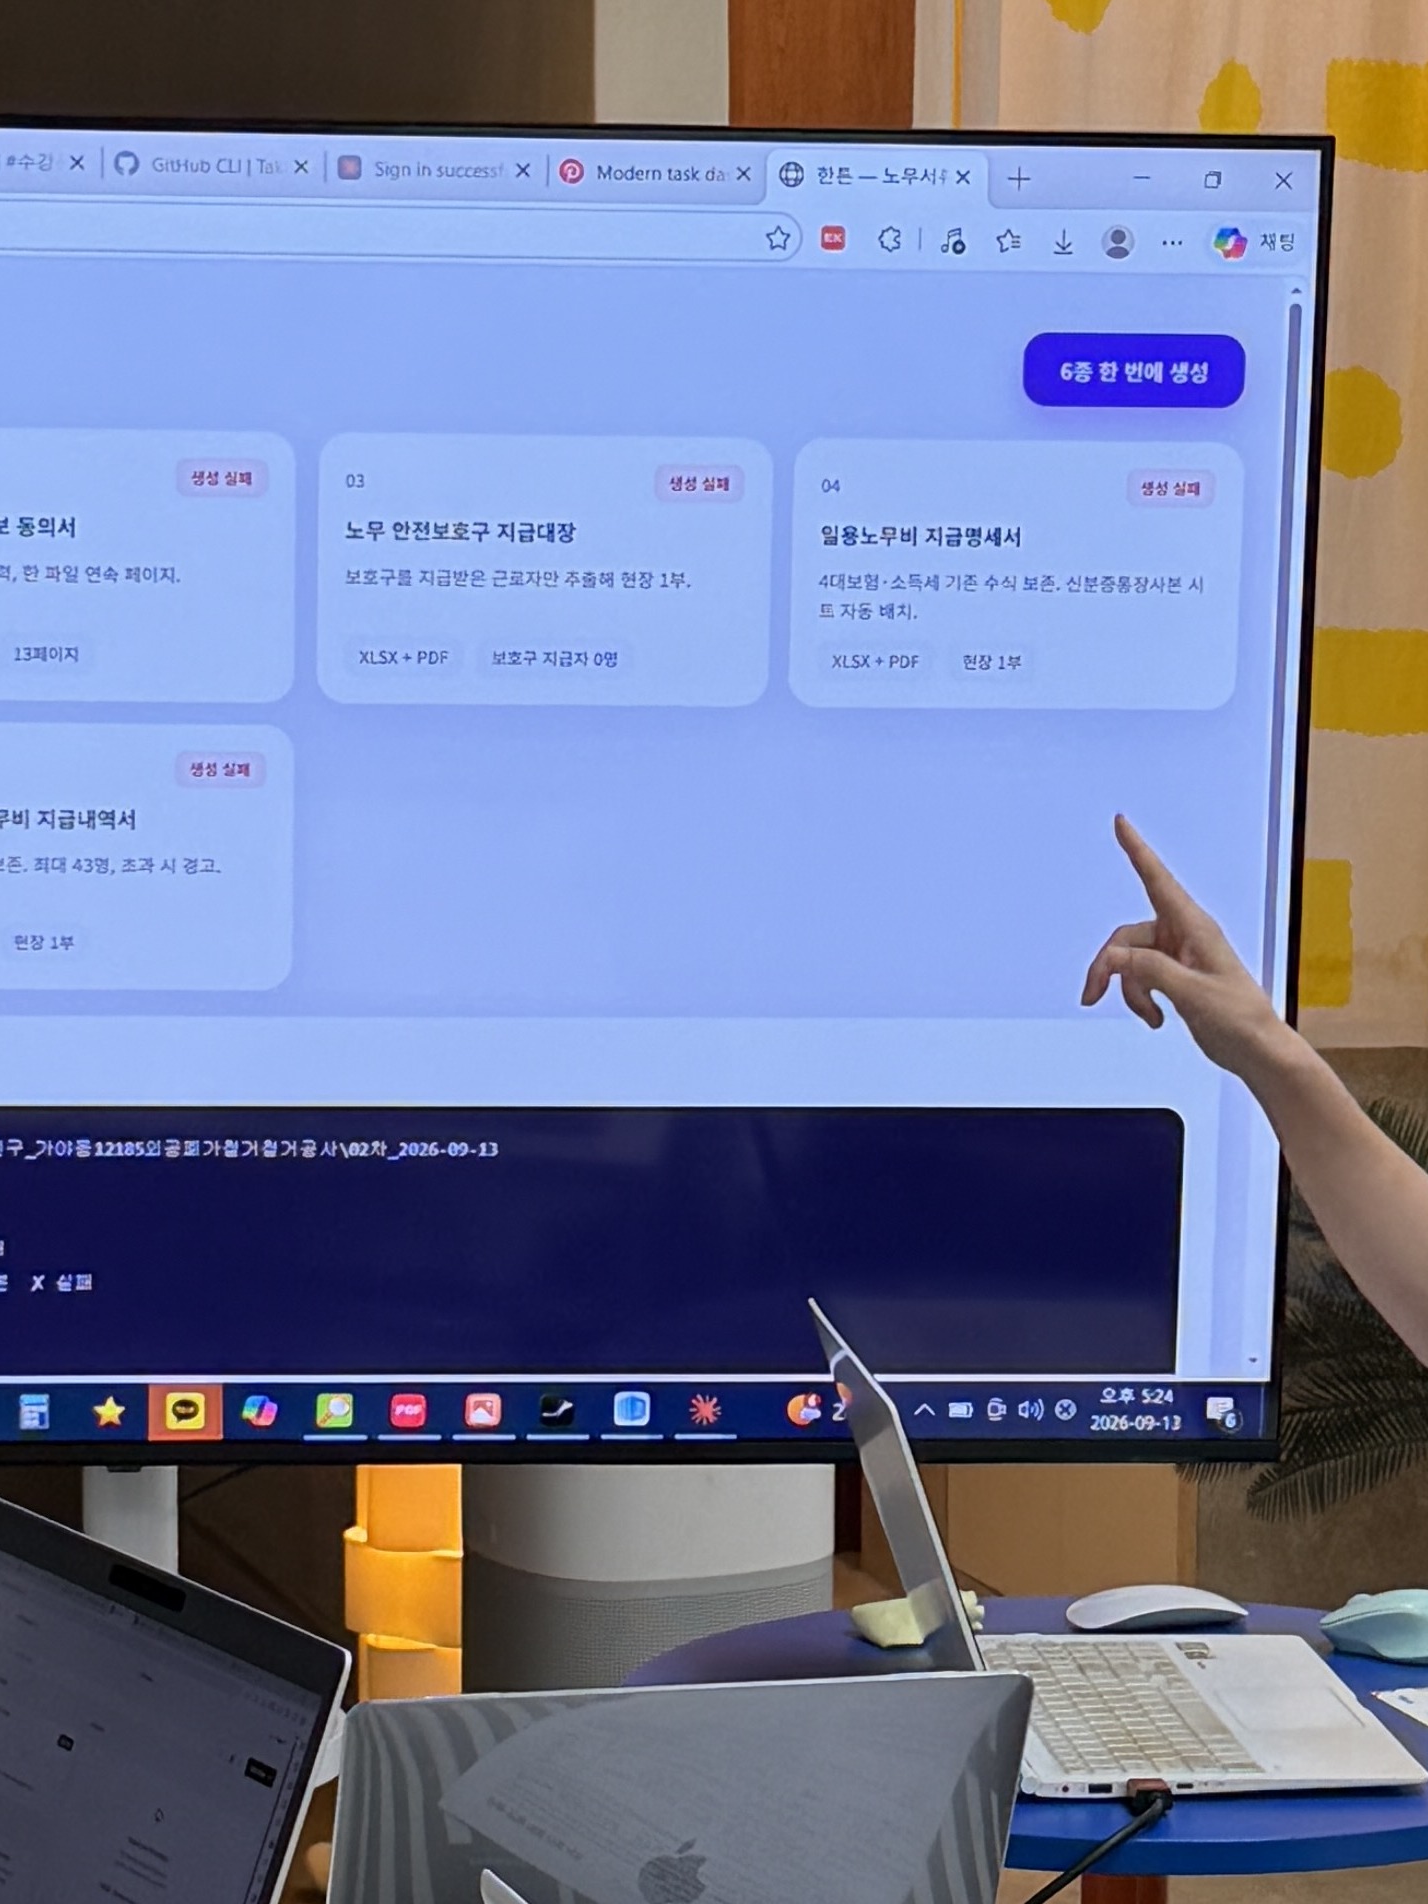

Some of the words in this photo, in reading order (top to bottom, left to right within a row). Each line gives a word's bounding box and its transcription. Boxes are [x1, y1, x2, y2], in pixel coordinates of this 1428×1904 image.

[152, 157, 210, 175] GitHub
[375, 161, 411, 181] Sign
[417, 161, 432, 181] in
[597, 165, 661, 182] Modern
[667, 165, 699, 182] task
[1260, 232, 1294, 252] 채팅
[1060, 362, 1094, 384] 6종
[1098, 360, 1120, 382] 한
[1124, 362, 1164, 384] 번에
[1170, 362, 1208, 384] 생성
[346, 474, 364, 488] 03
[820, 478, 840, 494] 04
[16, 516, 76, 538] 동의서
[344, 520, 386, 542] 노무
[392, 520, 490, 542] 안전보호구
[498, 522, 576, 544] 지급대장
[822, 526, 918, 548] 일용노무비
[924, 526, 1020, 548] 지급명세서
[44, 564, 78, 584] 파일
[124, 566, 180, 584] 페이지.
[344, 568, 412, 586] 보호구를
[492, 570, 560, 588] 근로자만
[620, 572, 654, 590] 현장
[660, 572, 692, 588] 1부.
[1188, 576, 1204, 594] 시
[840, 602, 874, 620] 자동
[360, 650, 398, 664] XLSX
[416, 650, 448, 666] PDF
[492, 650, 538, 666] 보호구
[832, 654, 870, 670] XLSX
[888, 654, 920, 668] PDF
[962, 654, 992, 670] 현장
[998, 656, 1022, 670] 1부
[36, 808, 136, 830] 지급내역서
[160, 858, 176, 874] 시
[50, 936, 74, 950] 1부
[1100, 1387, 1136, 1405] 오후
[1142, 1387, 1174, 1405] 5:24
[1090, 1415, 1181, 1432] 2026-09-13
